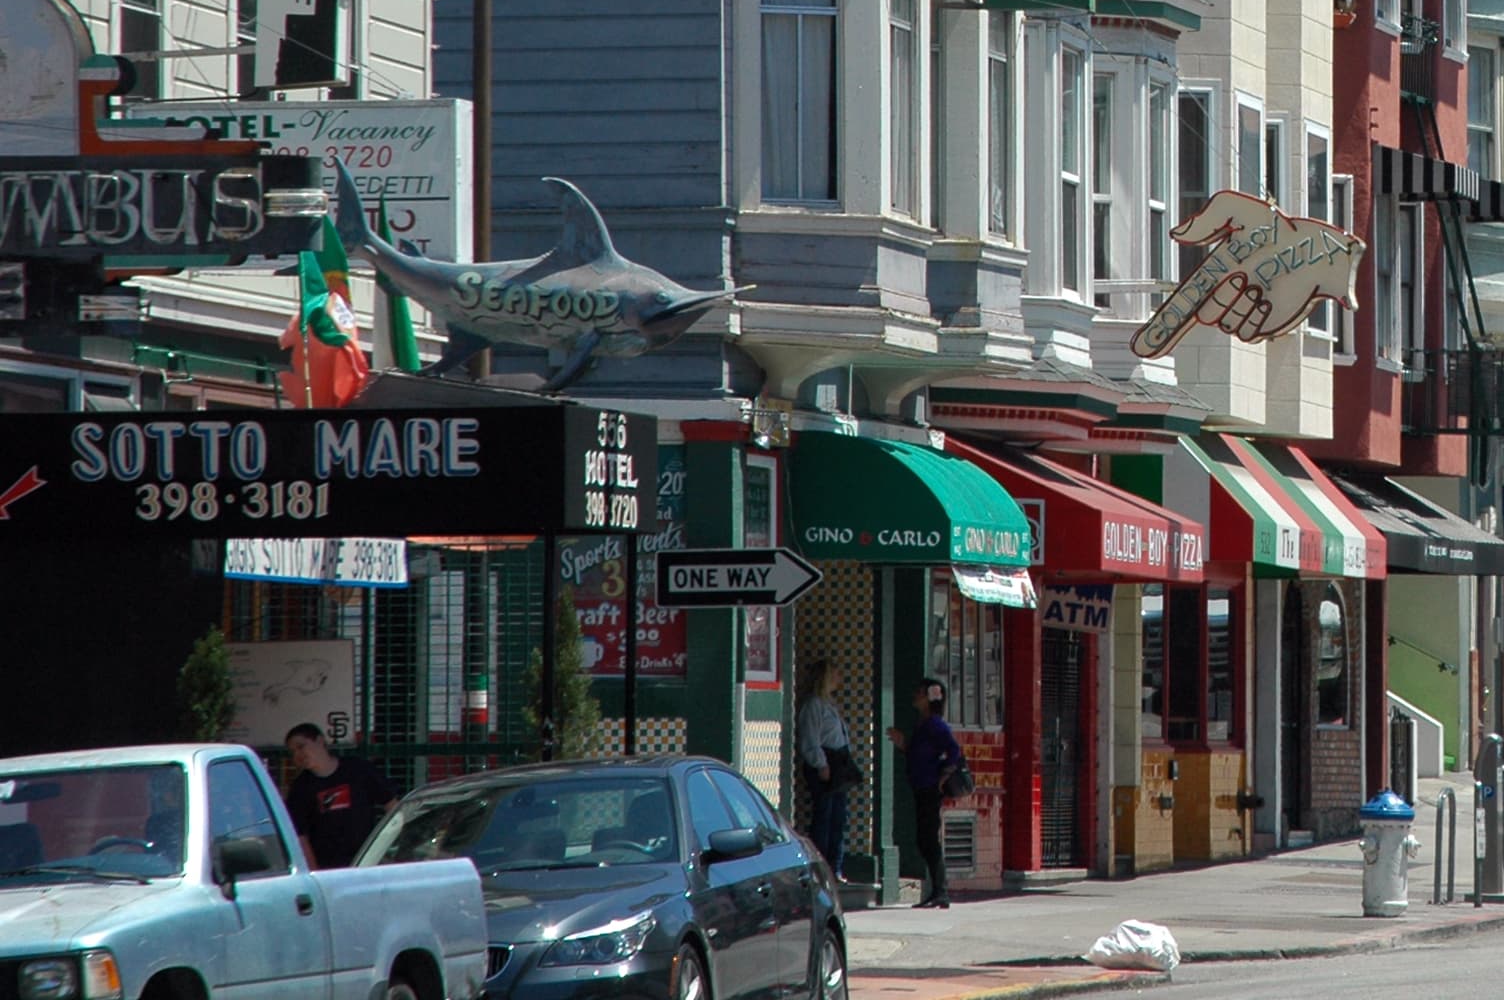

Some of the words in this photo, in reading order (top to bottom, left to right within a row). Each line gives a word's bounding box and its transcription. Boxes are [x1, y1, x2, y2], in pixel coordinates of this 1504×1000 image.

[300, 110, 437, 151] Vacancy
[1254, 229, 1352, 291] PIZZA
[1143, 254, 1229, 349] GOLDEN
[1226, 216, 1278, 264] BOY
[70, 420, 267, 482] SOTTO
[314, 417, 481, 479] MARE
[597, 411, 627, 449] 556
[585, 450, 638, 489] HOTEL
[804, 526, 853, 544] GINO
[877, 529, 941, 547] CARLO
[1103, 521, 1142, 563] GOLDEN
[1148, 528, 1168, 566] BOY
[1173, 531, 1203, 571] PIZZA
[561, 535, 622, 585] Sports
[673, 568, 719, 589] ONE
[726, 567, 771, 588] WAY
[575, 602, 621, 626] raft
[1043, 602, 1110, 628] ATM
